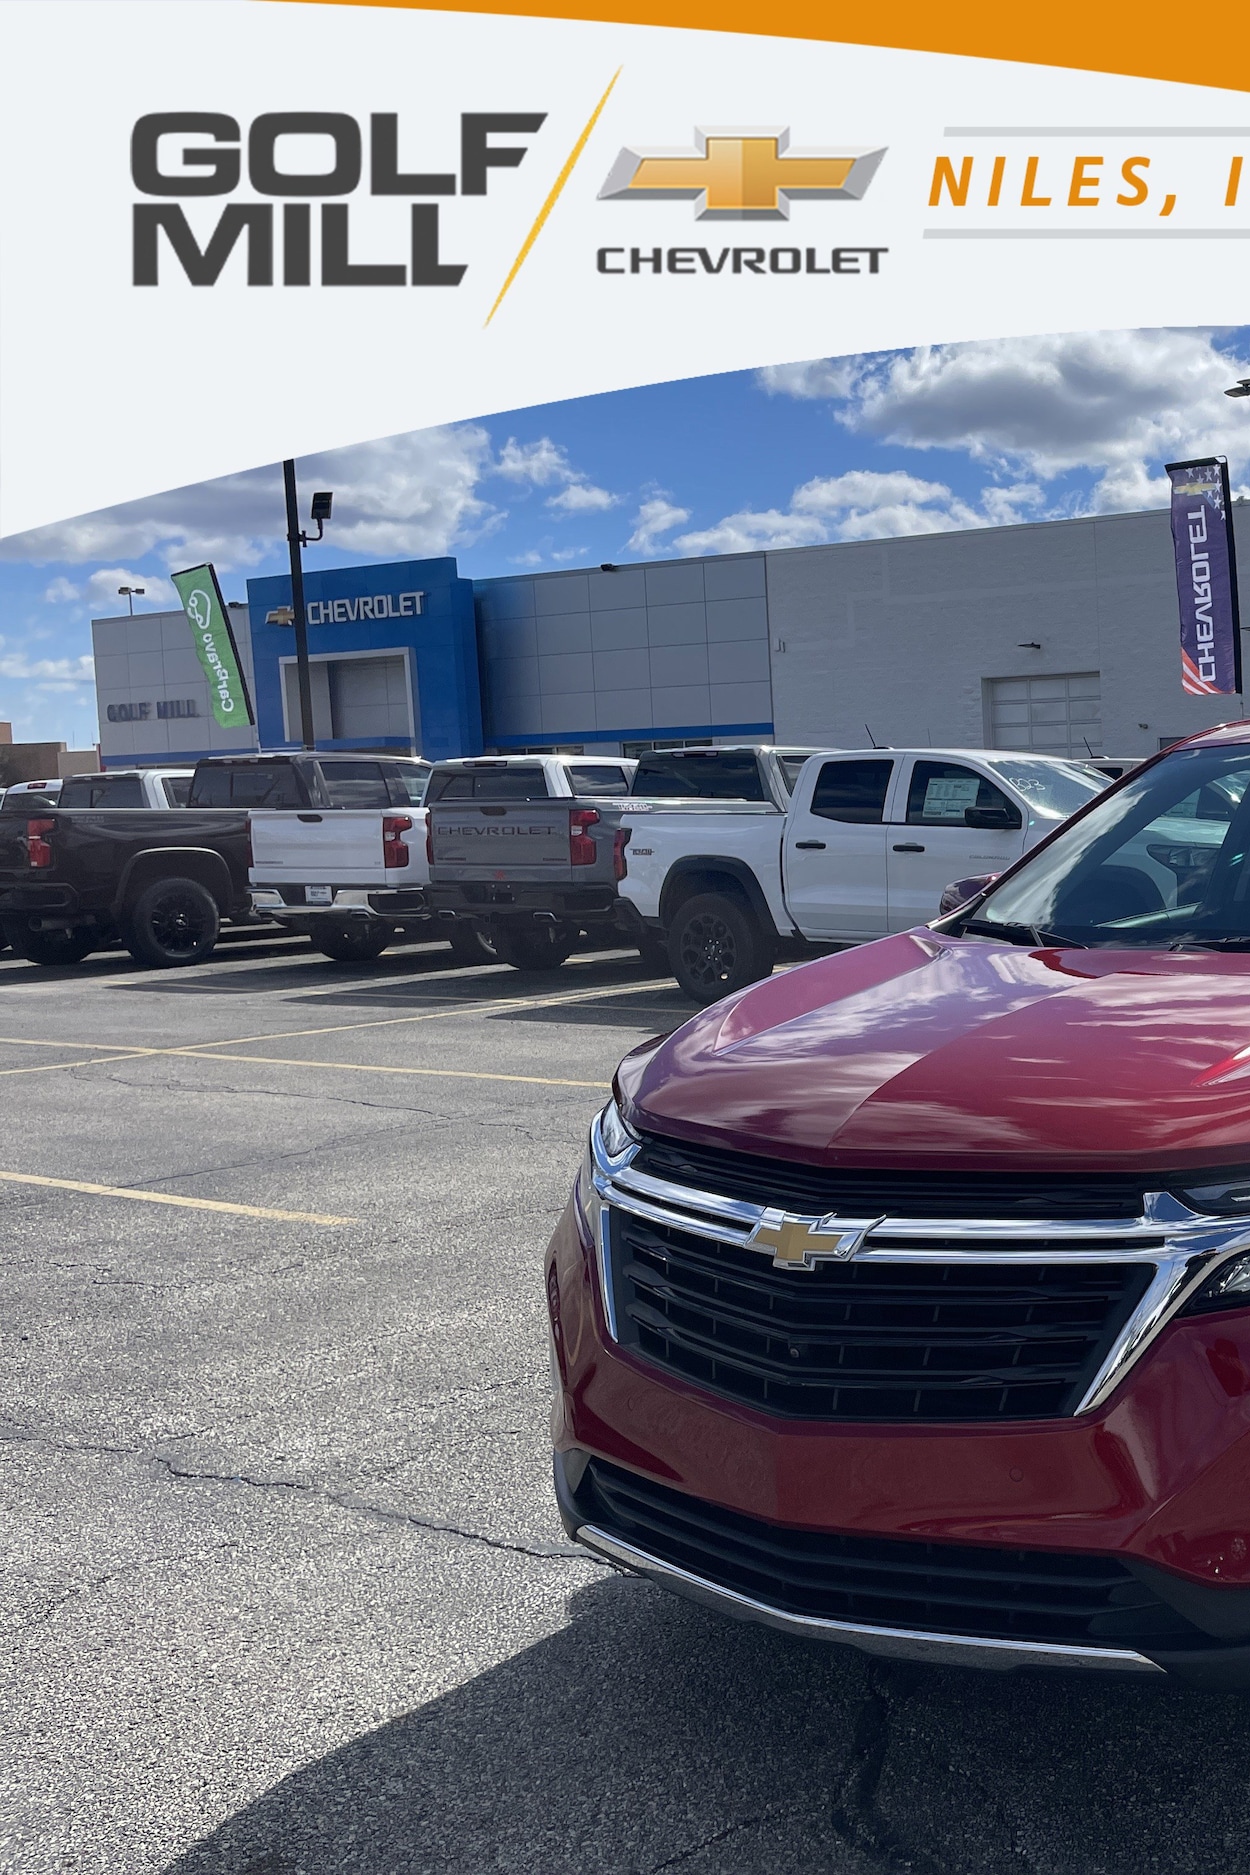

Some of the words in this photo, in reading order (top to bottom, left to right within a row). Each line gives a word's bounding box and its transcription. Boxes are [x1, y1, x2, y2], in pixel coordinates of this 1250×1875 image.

[307, 591, 425, 625] CHEVROLET
[107, 702, 152, 722] GOLF
[157, 699, 200, 719] MILL
[438, 826, 556, 836] CHEVROLET
